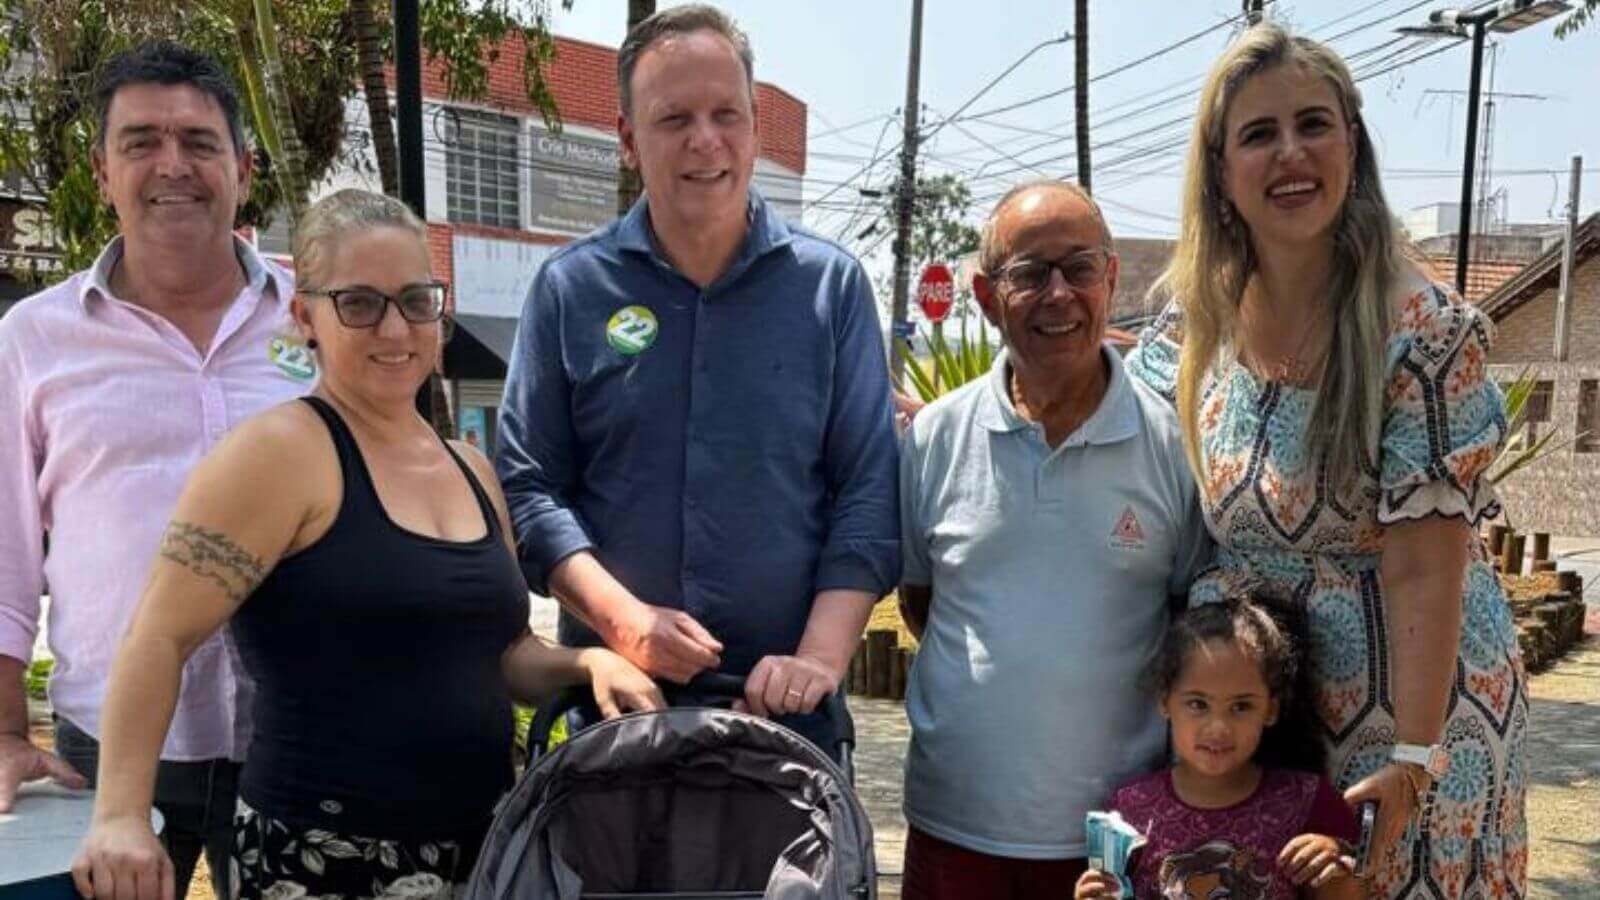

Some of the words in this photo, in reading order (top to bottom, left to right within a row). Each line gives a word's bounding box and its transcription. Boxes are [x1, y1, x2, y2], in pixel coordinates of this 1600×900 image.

[919, 281, 951, 303] PARE
[608, 309, 656, 346] 22
[272, 340, 313, 374] 22
